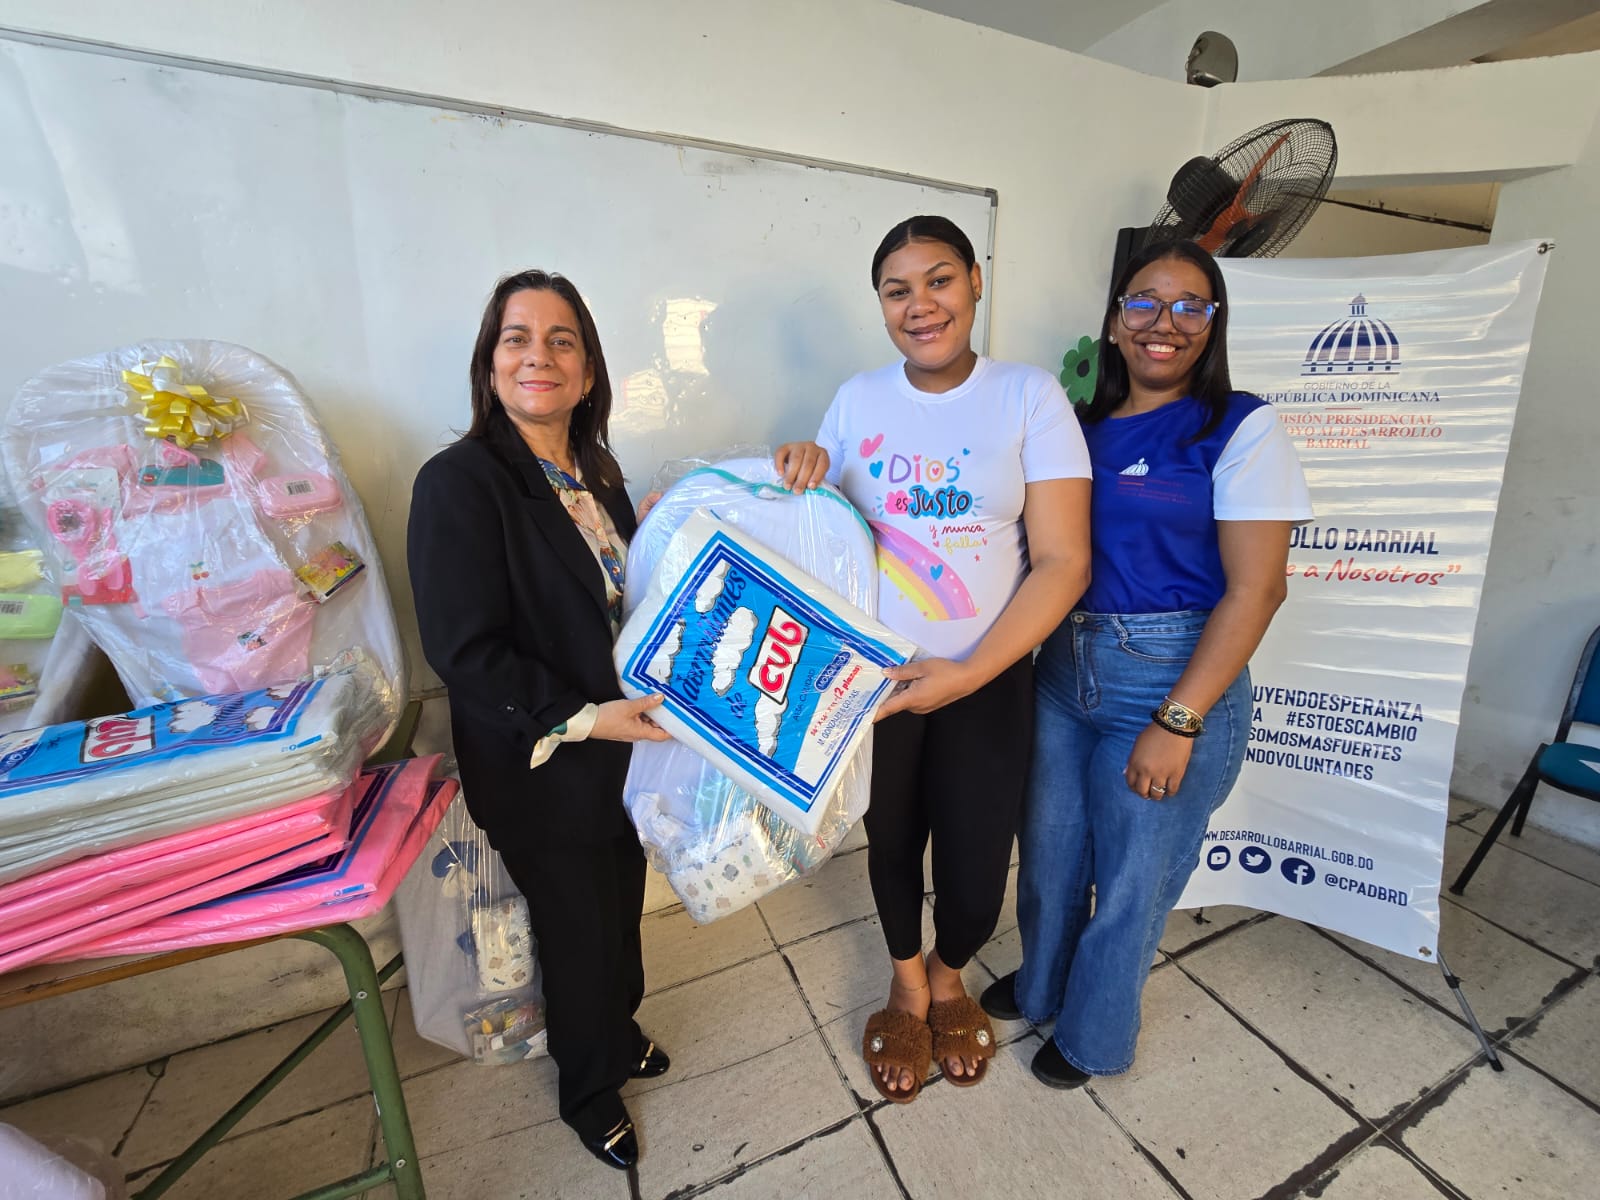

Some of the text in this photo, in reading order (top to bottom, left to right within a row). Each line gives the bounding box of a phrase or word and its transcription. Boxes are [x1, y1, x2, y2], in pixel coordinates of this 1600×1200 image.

[1304, 381, 1391, 391] GOBIERNO DE LA
[1341, 391, 1440, 403] DOMINICANA
[1280, 411, 1436, 426] ISIÓN PRESIDENCIAL
[1287, 426, 1442, 438] OYO AL DESARROLLO
[1306, 438, 1371, 450] BARRIAL
[929, 523, 985, 539] y nunca
[1289, 526, 1439, 555] OLLO BARRIAL
[1303, 565, 1320, 578] a
[1253, 685, 1424, 723] UYENDOESPERANZA
[1286, 711, 1418, 742] #ESTOESCAMBIO
[1248, 727, 1402, 762] SOMOSMASFUERTES
[1245, 747, 1374, 781] NDOVOLUNTADES
[1324, 873, 1408, 907] @CPADBRD
